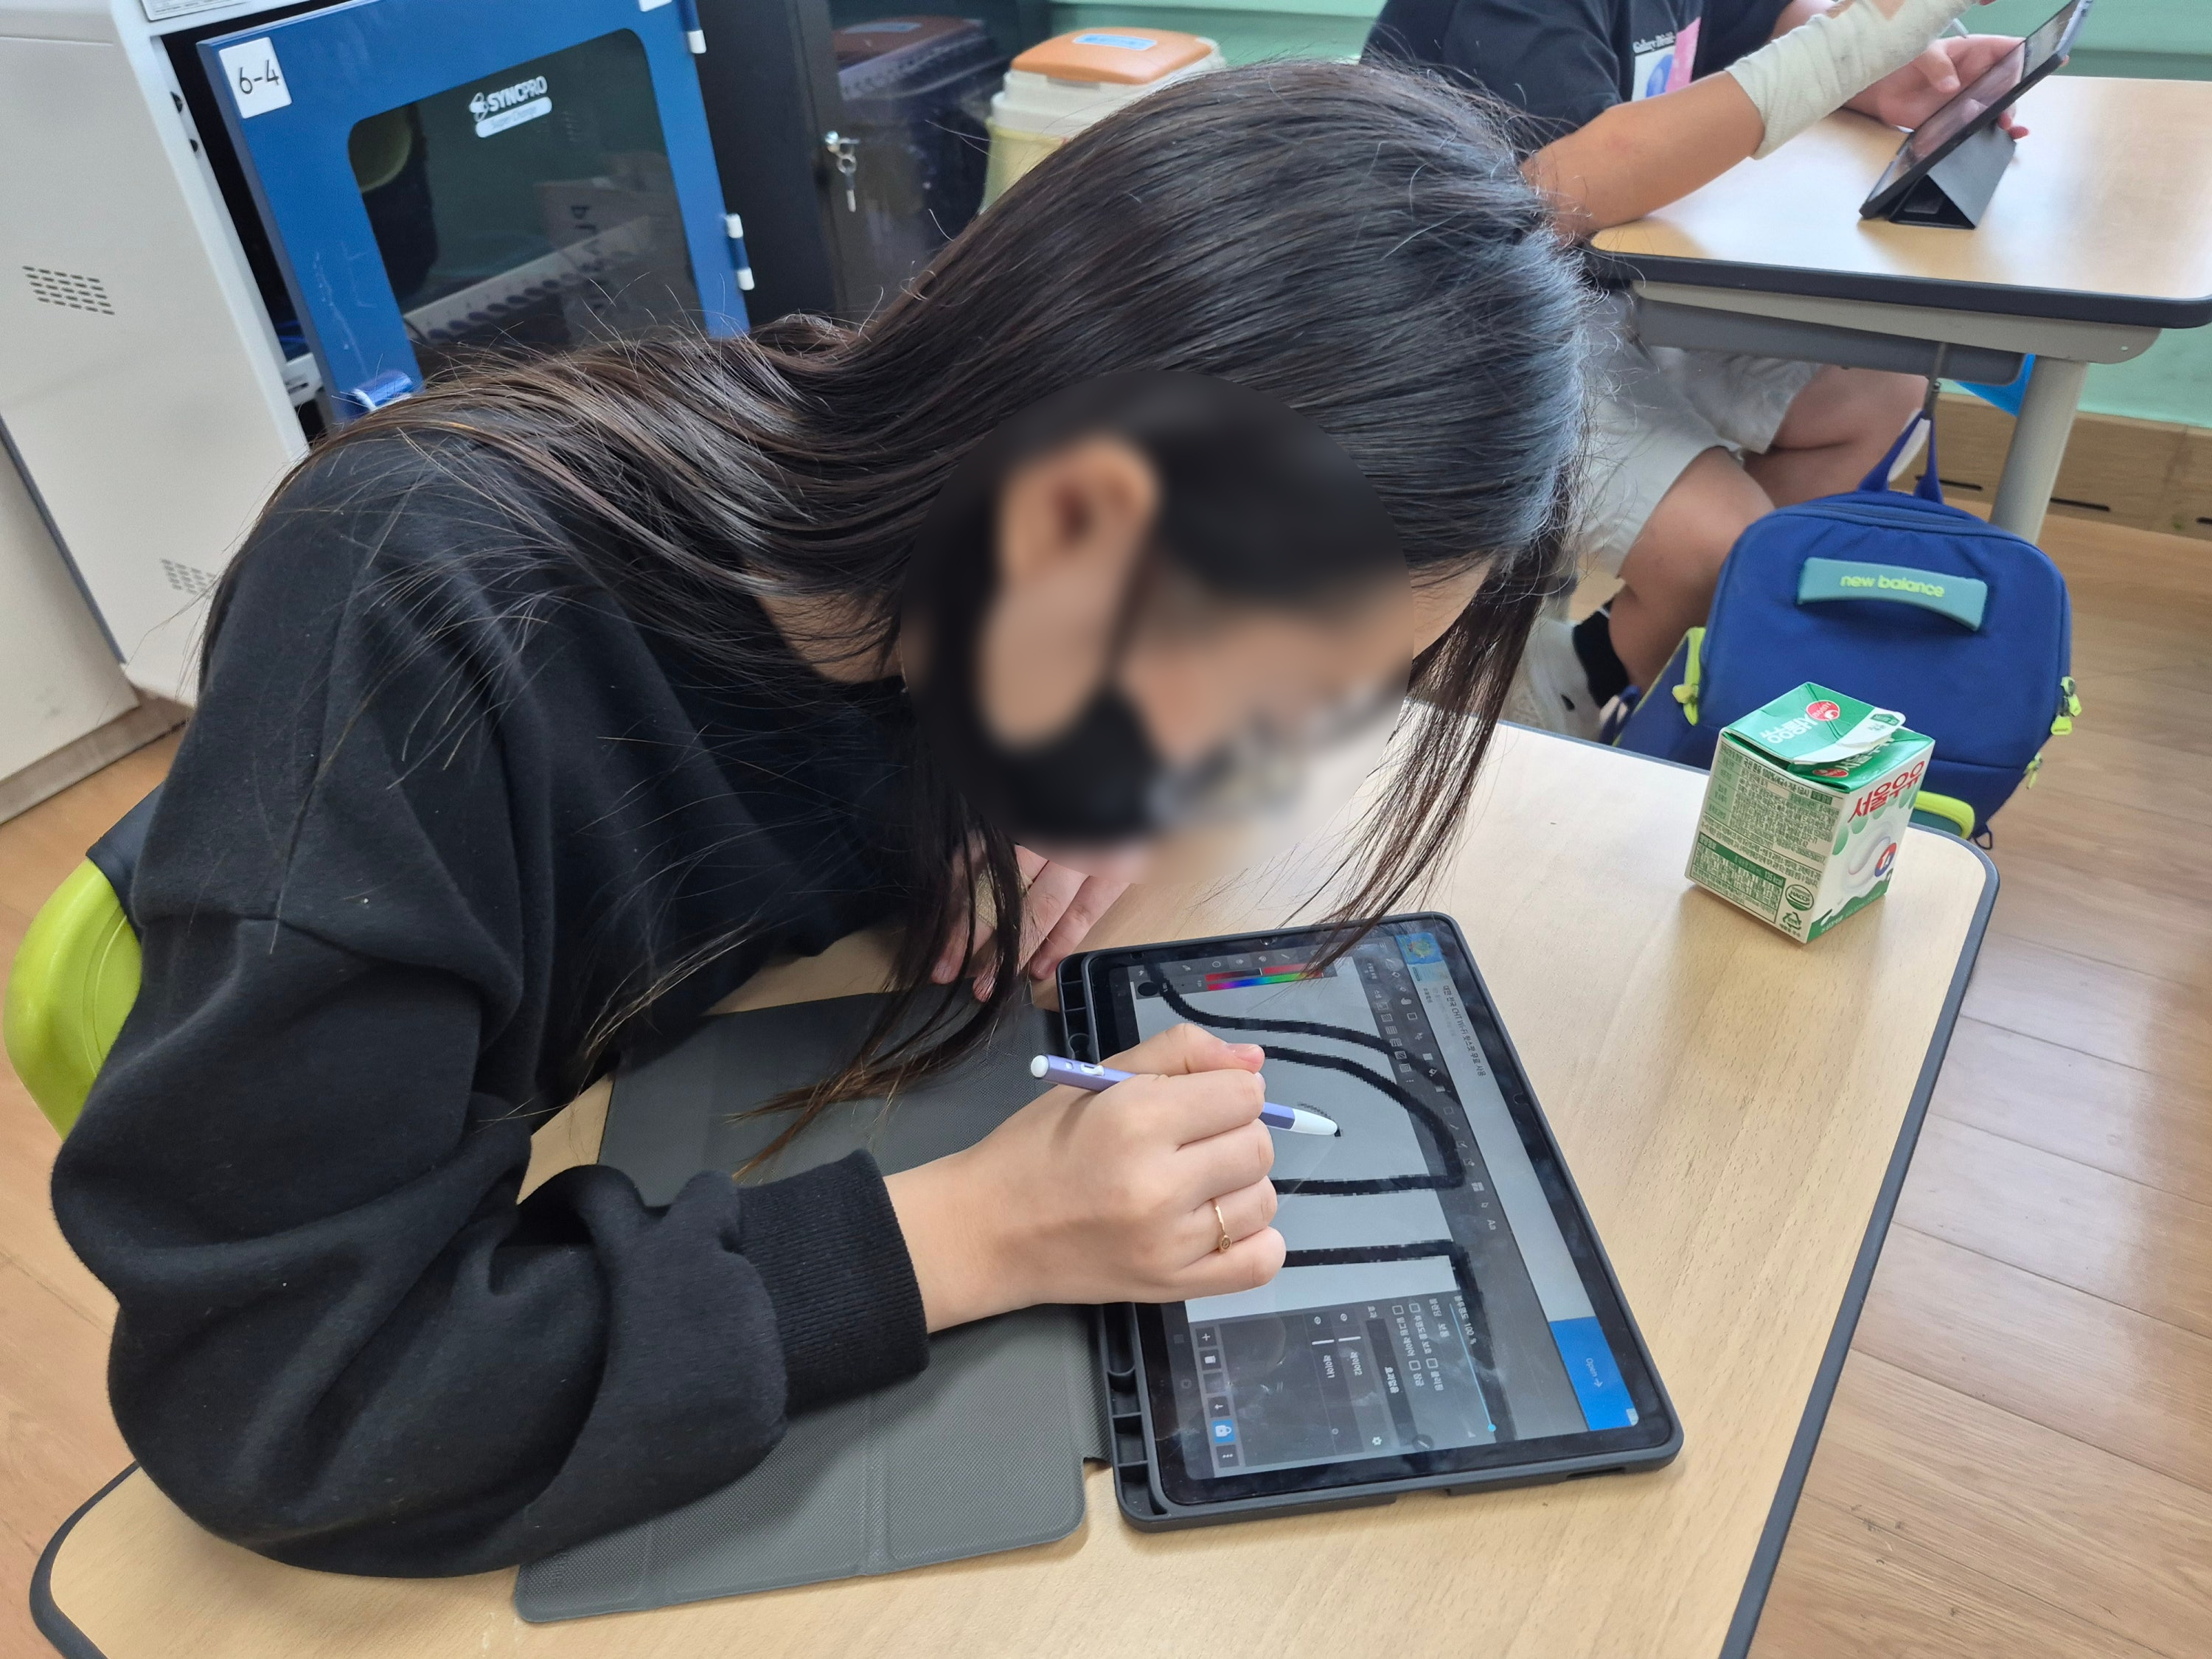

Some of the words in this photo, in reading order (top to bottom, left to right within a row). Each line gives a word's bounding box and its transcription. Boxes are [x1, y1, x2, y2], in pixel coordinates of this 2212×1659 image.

[239, 60, 279, 94] 6-4
[487, 76, 548, 111] SYNCPRO
[1840, 575, 1875, 588] new
[1877, 575, 1945, 598] balance
[1759, 714, 1818, 744] 서울우유
[1848, 760, 1924, 824] 서울우유
[1451, 1008, 1462, 1019] CHT
[1457, 1019, 1469, 1034] Wi-Fi
[1487, 1220, 1496, 1231] Aa
[1464, 1323, 1475, 1336] 100
[1323, 1354, 1335, 1379] 레이어1
[1350, 1351, 1363, 1376] 레이어2
[1585, 1357, 1598, 1377] Open
